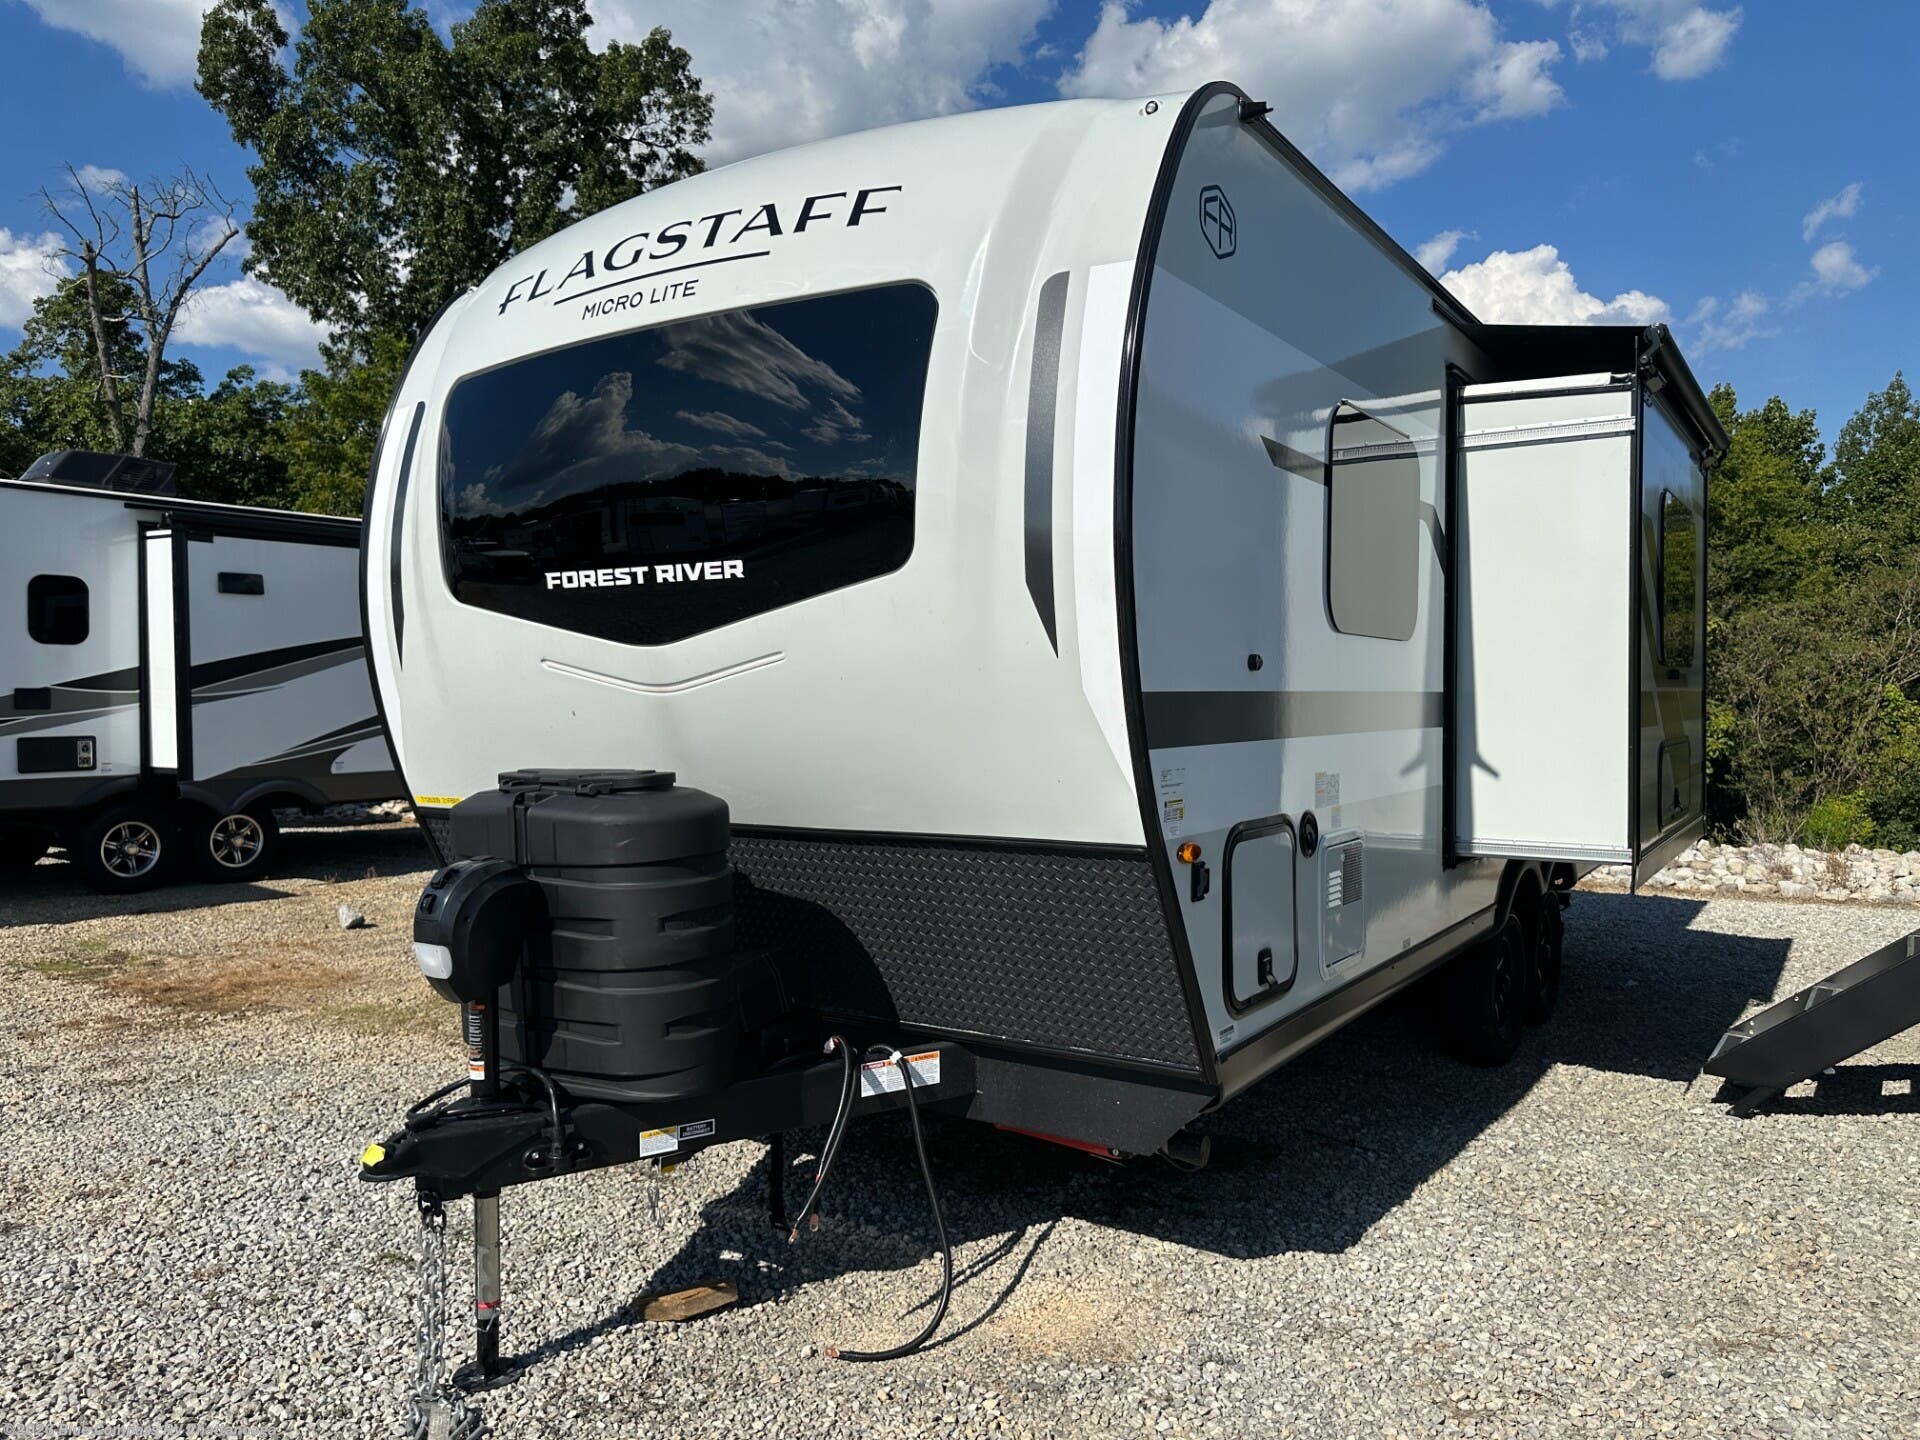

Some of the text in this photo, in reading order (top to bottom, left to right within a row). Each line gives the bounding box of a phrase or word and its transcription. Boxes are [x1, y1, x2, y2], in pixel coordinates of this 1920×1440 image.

[498, 185, 903, 316] FLAGSTAFF
[582, 279, 700, 321] MICRO LITE
[544, 559, 745, 590] FOREST RIVER
